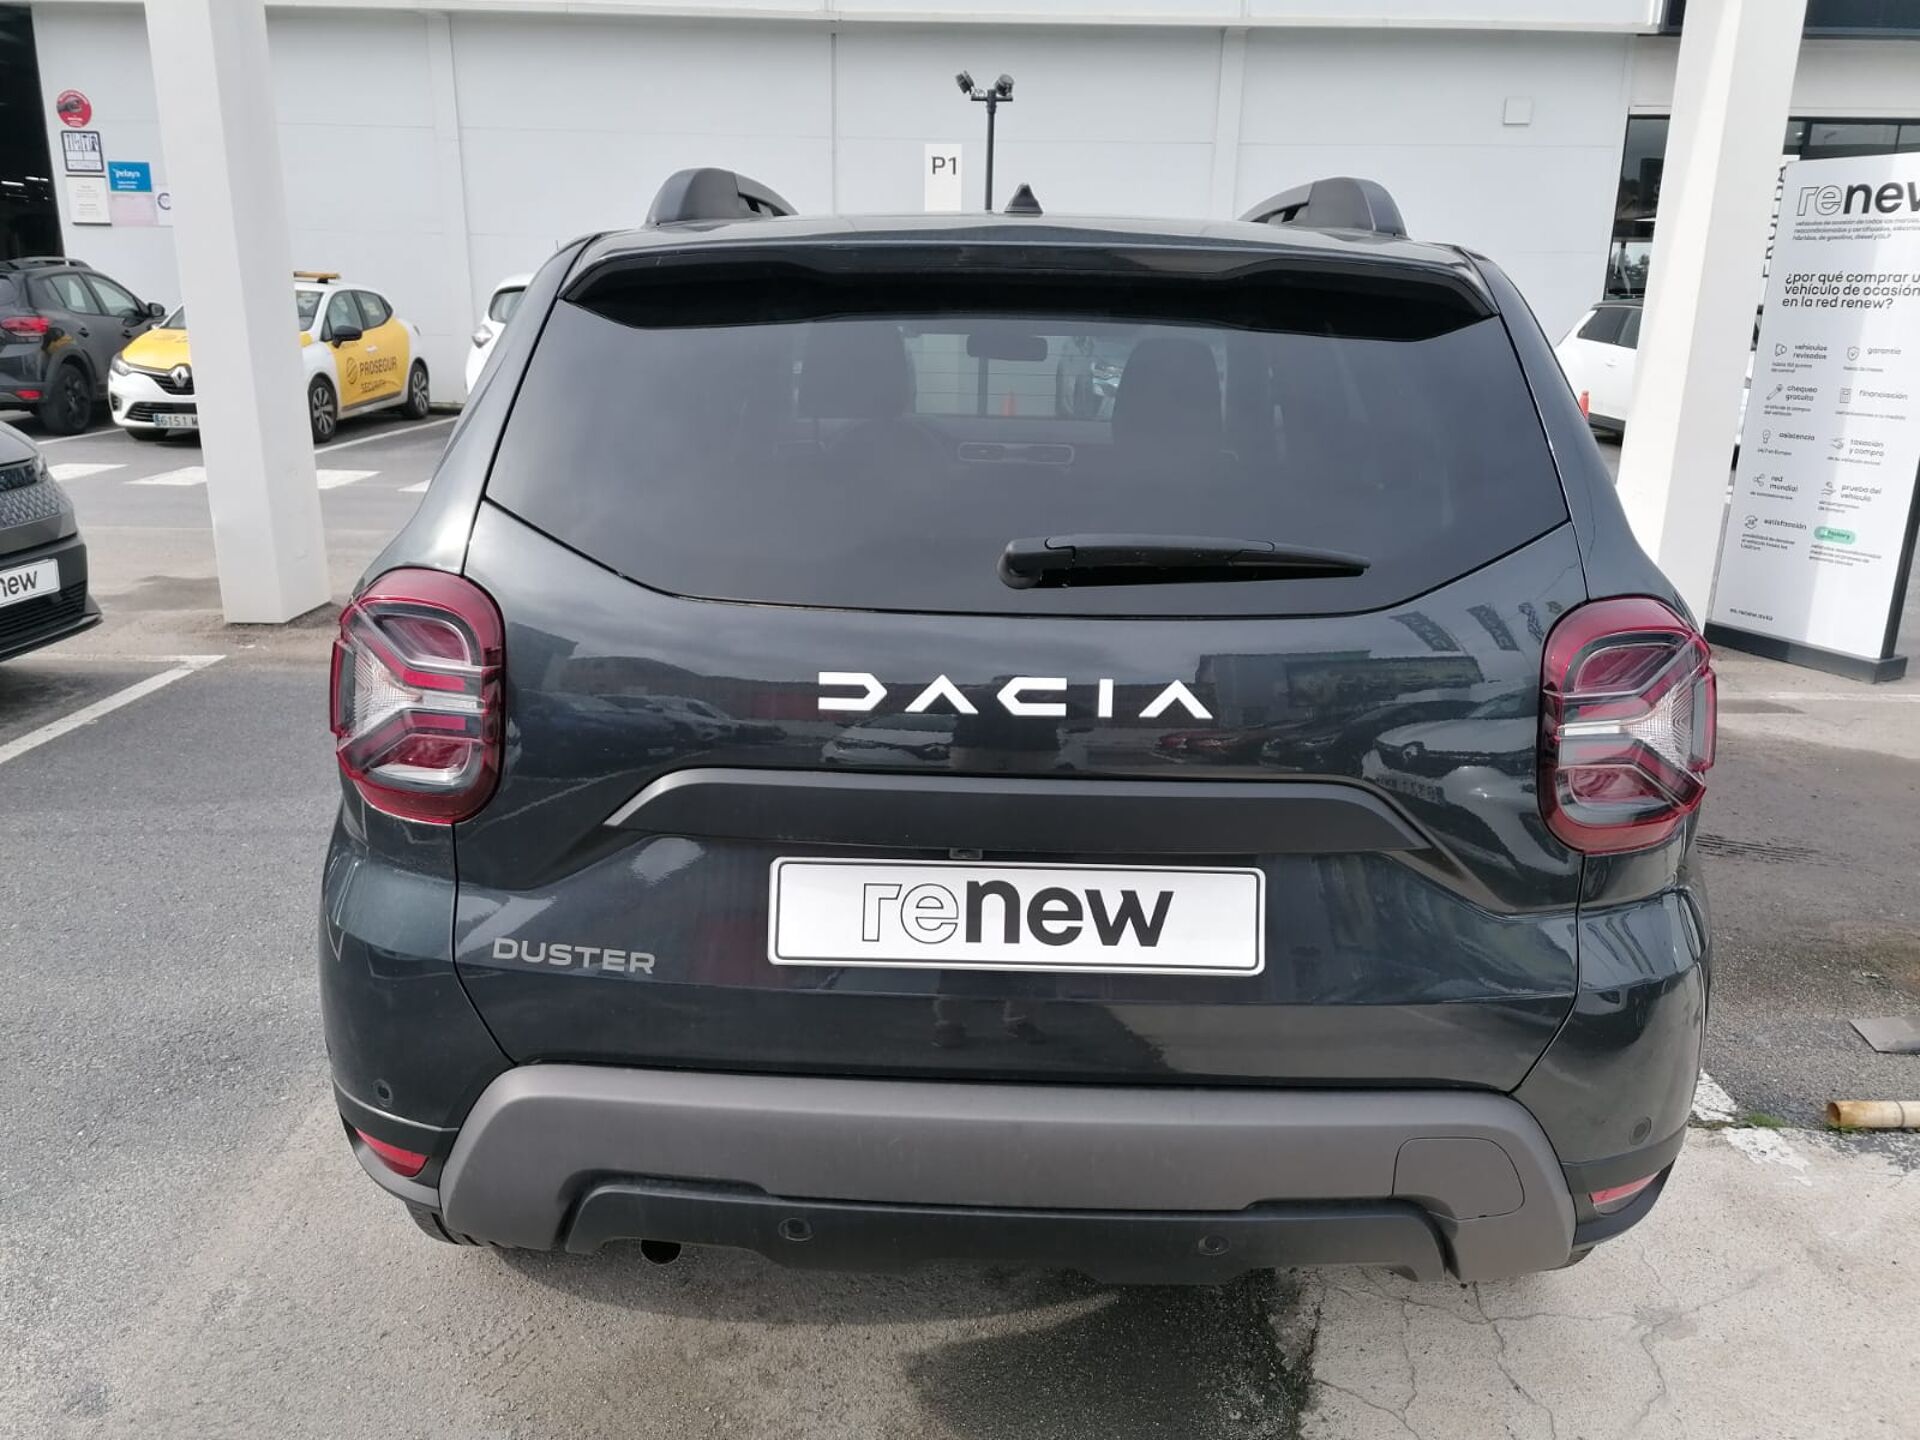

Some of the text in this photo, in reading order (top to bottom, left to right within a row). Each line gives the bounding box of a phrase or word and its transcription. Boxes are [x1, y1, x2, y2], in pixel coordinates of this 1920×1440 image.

[931, 156, 956, 175] P1
[1785, 273, 1815, 285] ¿por
[1818, 271, 1843, 285] qué
[1846, 273, 1908, 285] comprar
[1785, 284, 1920, 296] vehículo de ocasión
[1782, 296, 1893, 309] en la red renew?
[360, 356, 397, 376] PROSEGUR
[817, 671, 1214, 719] DACIA
[861, 879, 1174, 947] renew
[492, 937, 656, 974] DUSTER
